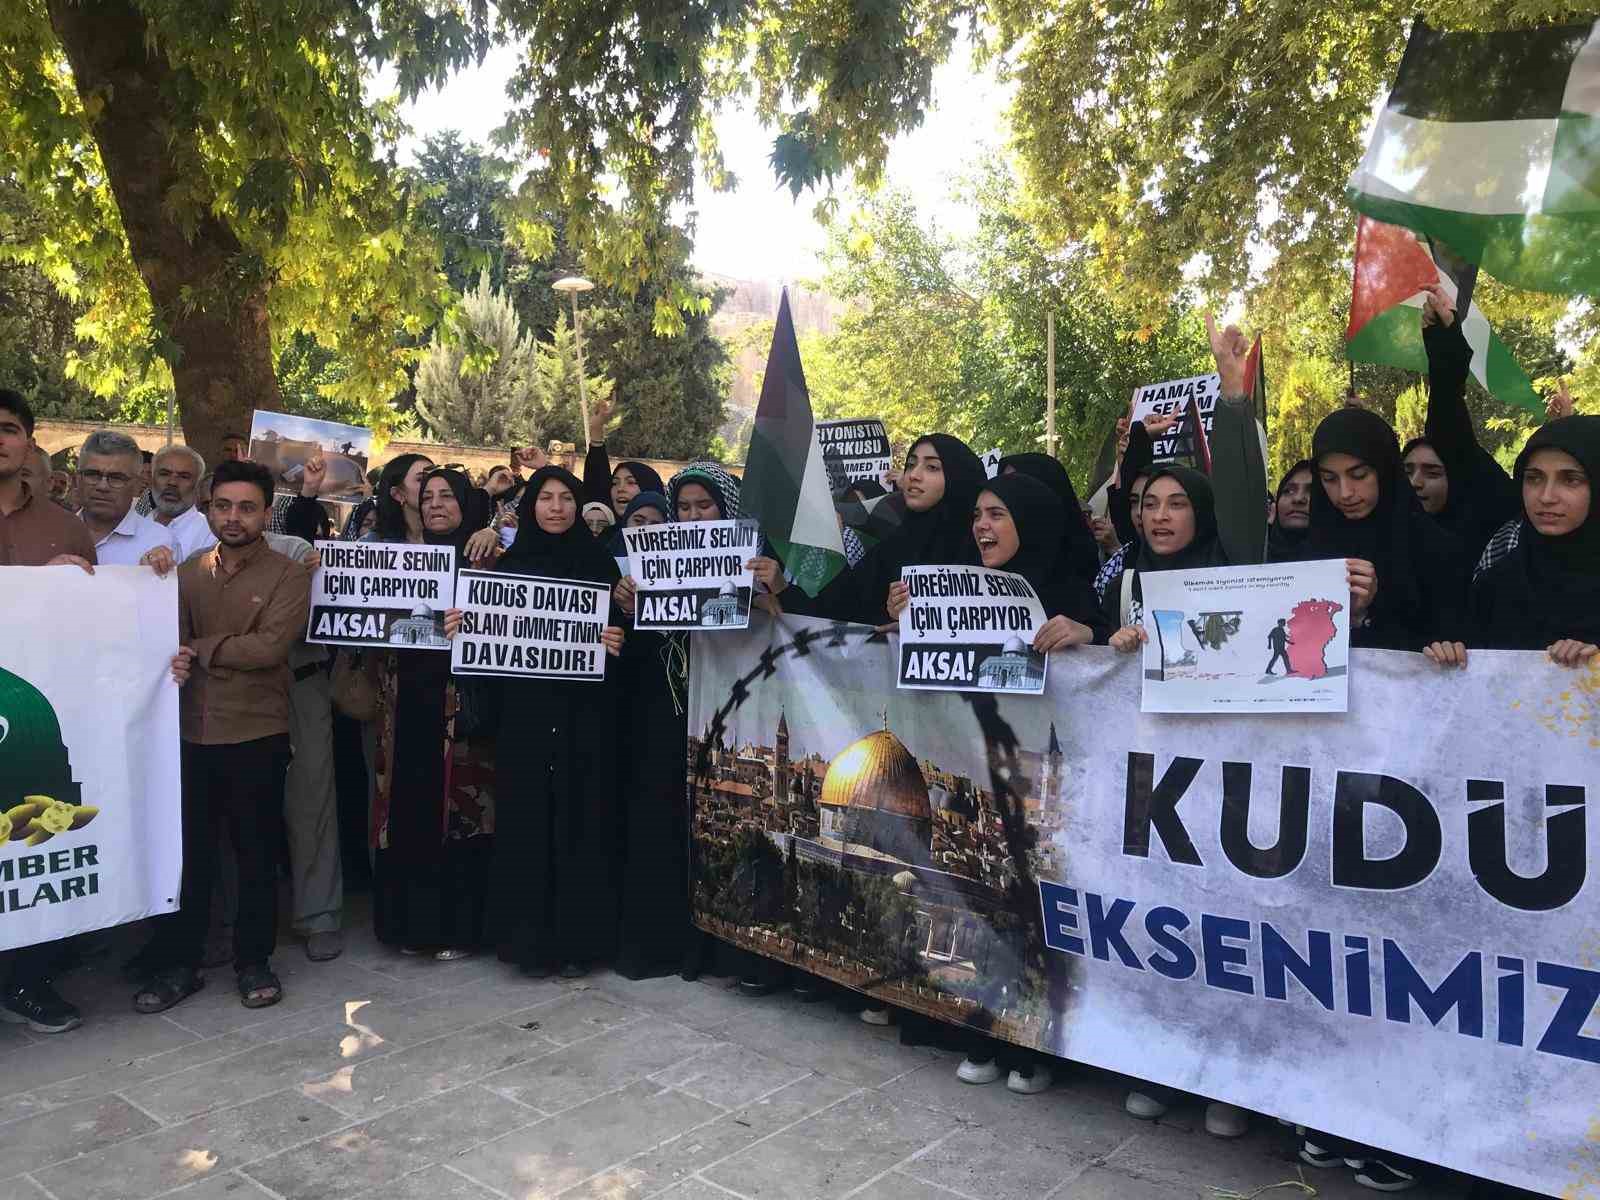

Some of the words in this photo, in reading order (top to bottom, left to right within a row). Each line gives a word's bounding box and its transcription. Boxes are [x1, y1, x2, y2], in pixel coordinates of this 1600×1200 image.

[1152, 396, 1212, 416] SEM
[627, 524, 706, 552] YÜREĞİMİZ
[710, 522, 754, 549] SENİN
[402, 548, 451, 572] SENİN
[641, 555, 672, 585] İÇİN
[675, 555, 742, 584] ÇARPIYOR
[324, 571, 355, 601] İÇİN
[360, 576, 438, 602] ÇARPIYOR
[468, 579, 528, 609] KUDÜS
[533, 585, 598, 615] DAVASI
[903, 568, 984, 598] YÜREĞİMİZ
[984, 574, 1035, 599] SENİN
[641, 595, 697, 621] AKSA!
[910, 602, 942, 637] İÇİN
[946, 606, 1033, 638] ÇARPIYOR
[315, 612, 386, 639] AKSA!
[462, 641, 596, 672] DAVASIDIR!
[905, 650, 975, 681] AKSA!
[1122, 751, 1587, 913] KUDÜ
[1037, 879, 1600, 1065] EKSENİMİZ
